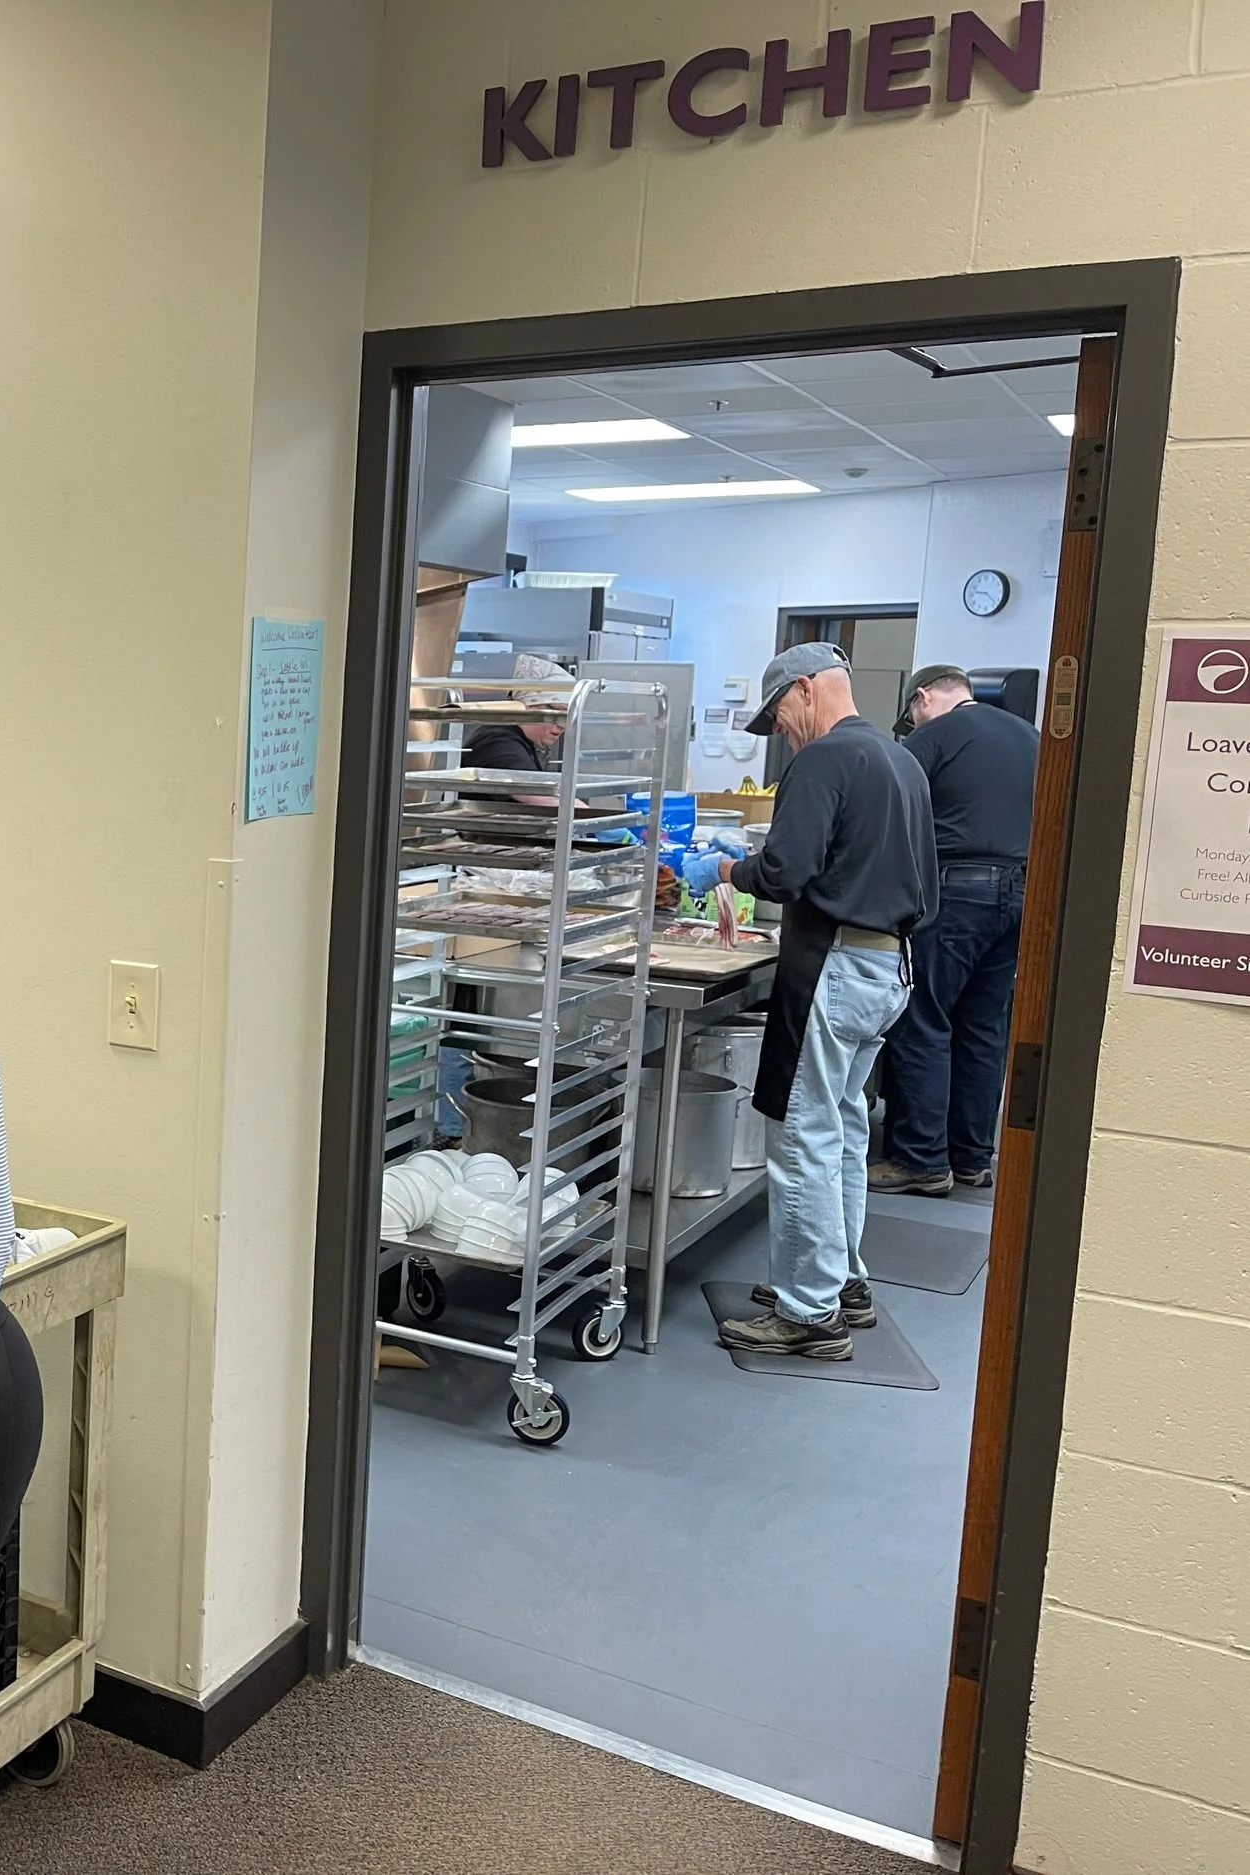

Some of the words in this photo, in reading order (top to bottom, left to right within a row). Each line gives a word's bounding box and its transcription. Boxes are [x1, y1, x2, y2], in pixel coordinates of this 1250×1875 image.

[481, 1, 1045, 168] KITCHEN
[1207, 773, 1250, 794] Co
[1196, 848, 1250, 864] Monday
[1198, 868, 1230, 882] Free!
[1180, 888, 1240, 903] Curbside
[1141, 946, 1231, 969] Volunteer
